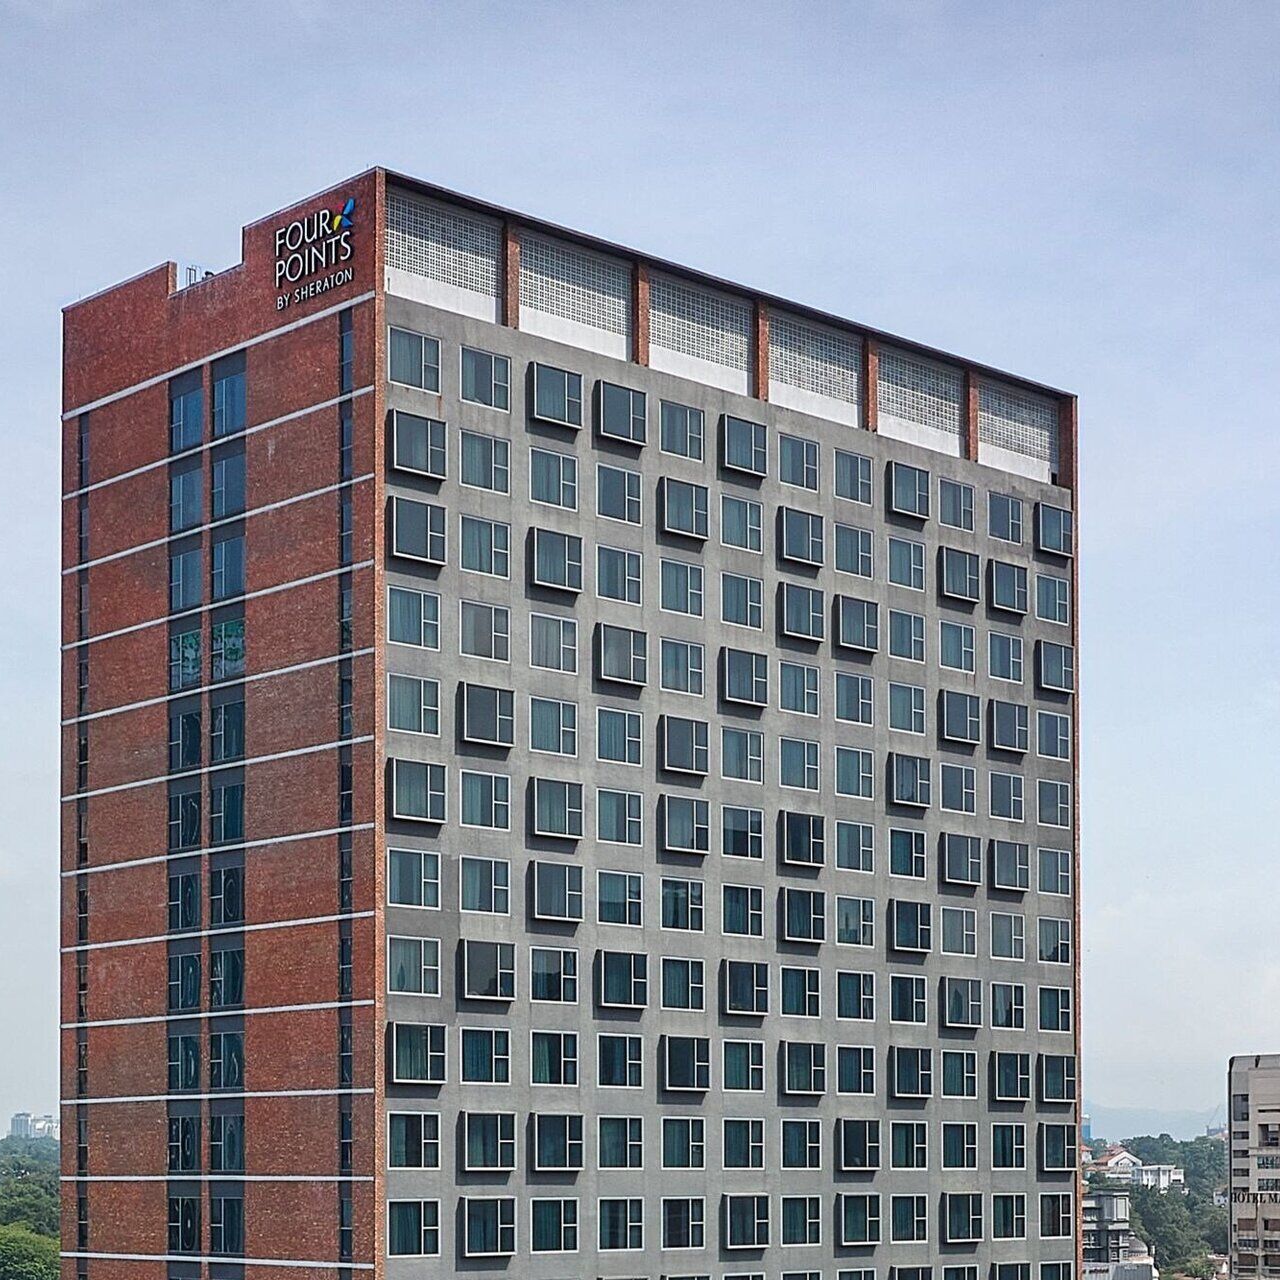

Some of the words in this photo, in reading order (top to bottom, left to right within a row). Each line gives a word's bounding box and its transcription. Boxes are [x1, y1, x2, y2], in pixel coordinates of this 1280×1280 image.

[275, 209, 332, 257] FOUR
[275, 230, 352, 288] POINTS
[277, 293, 291, 310] BY
[294, 267, 353, 303] SHERATON
[1230, 1192, 1267, 1204] HOTEL
